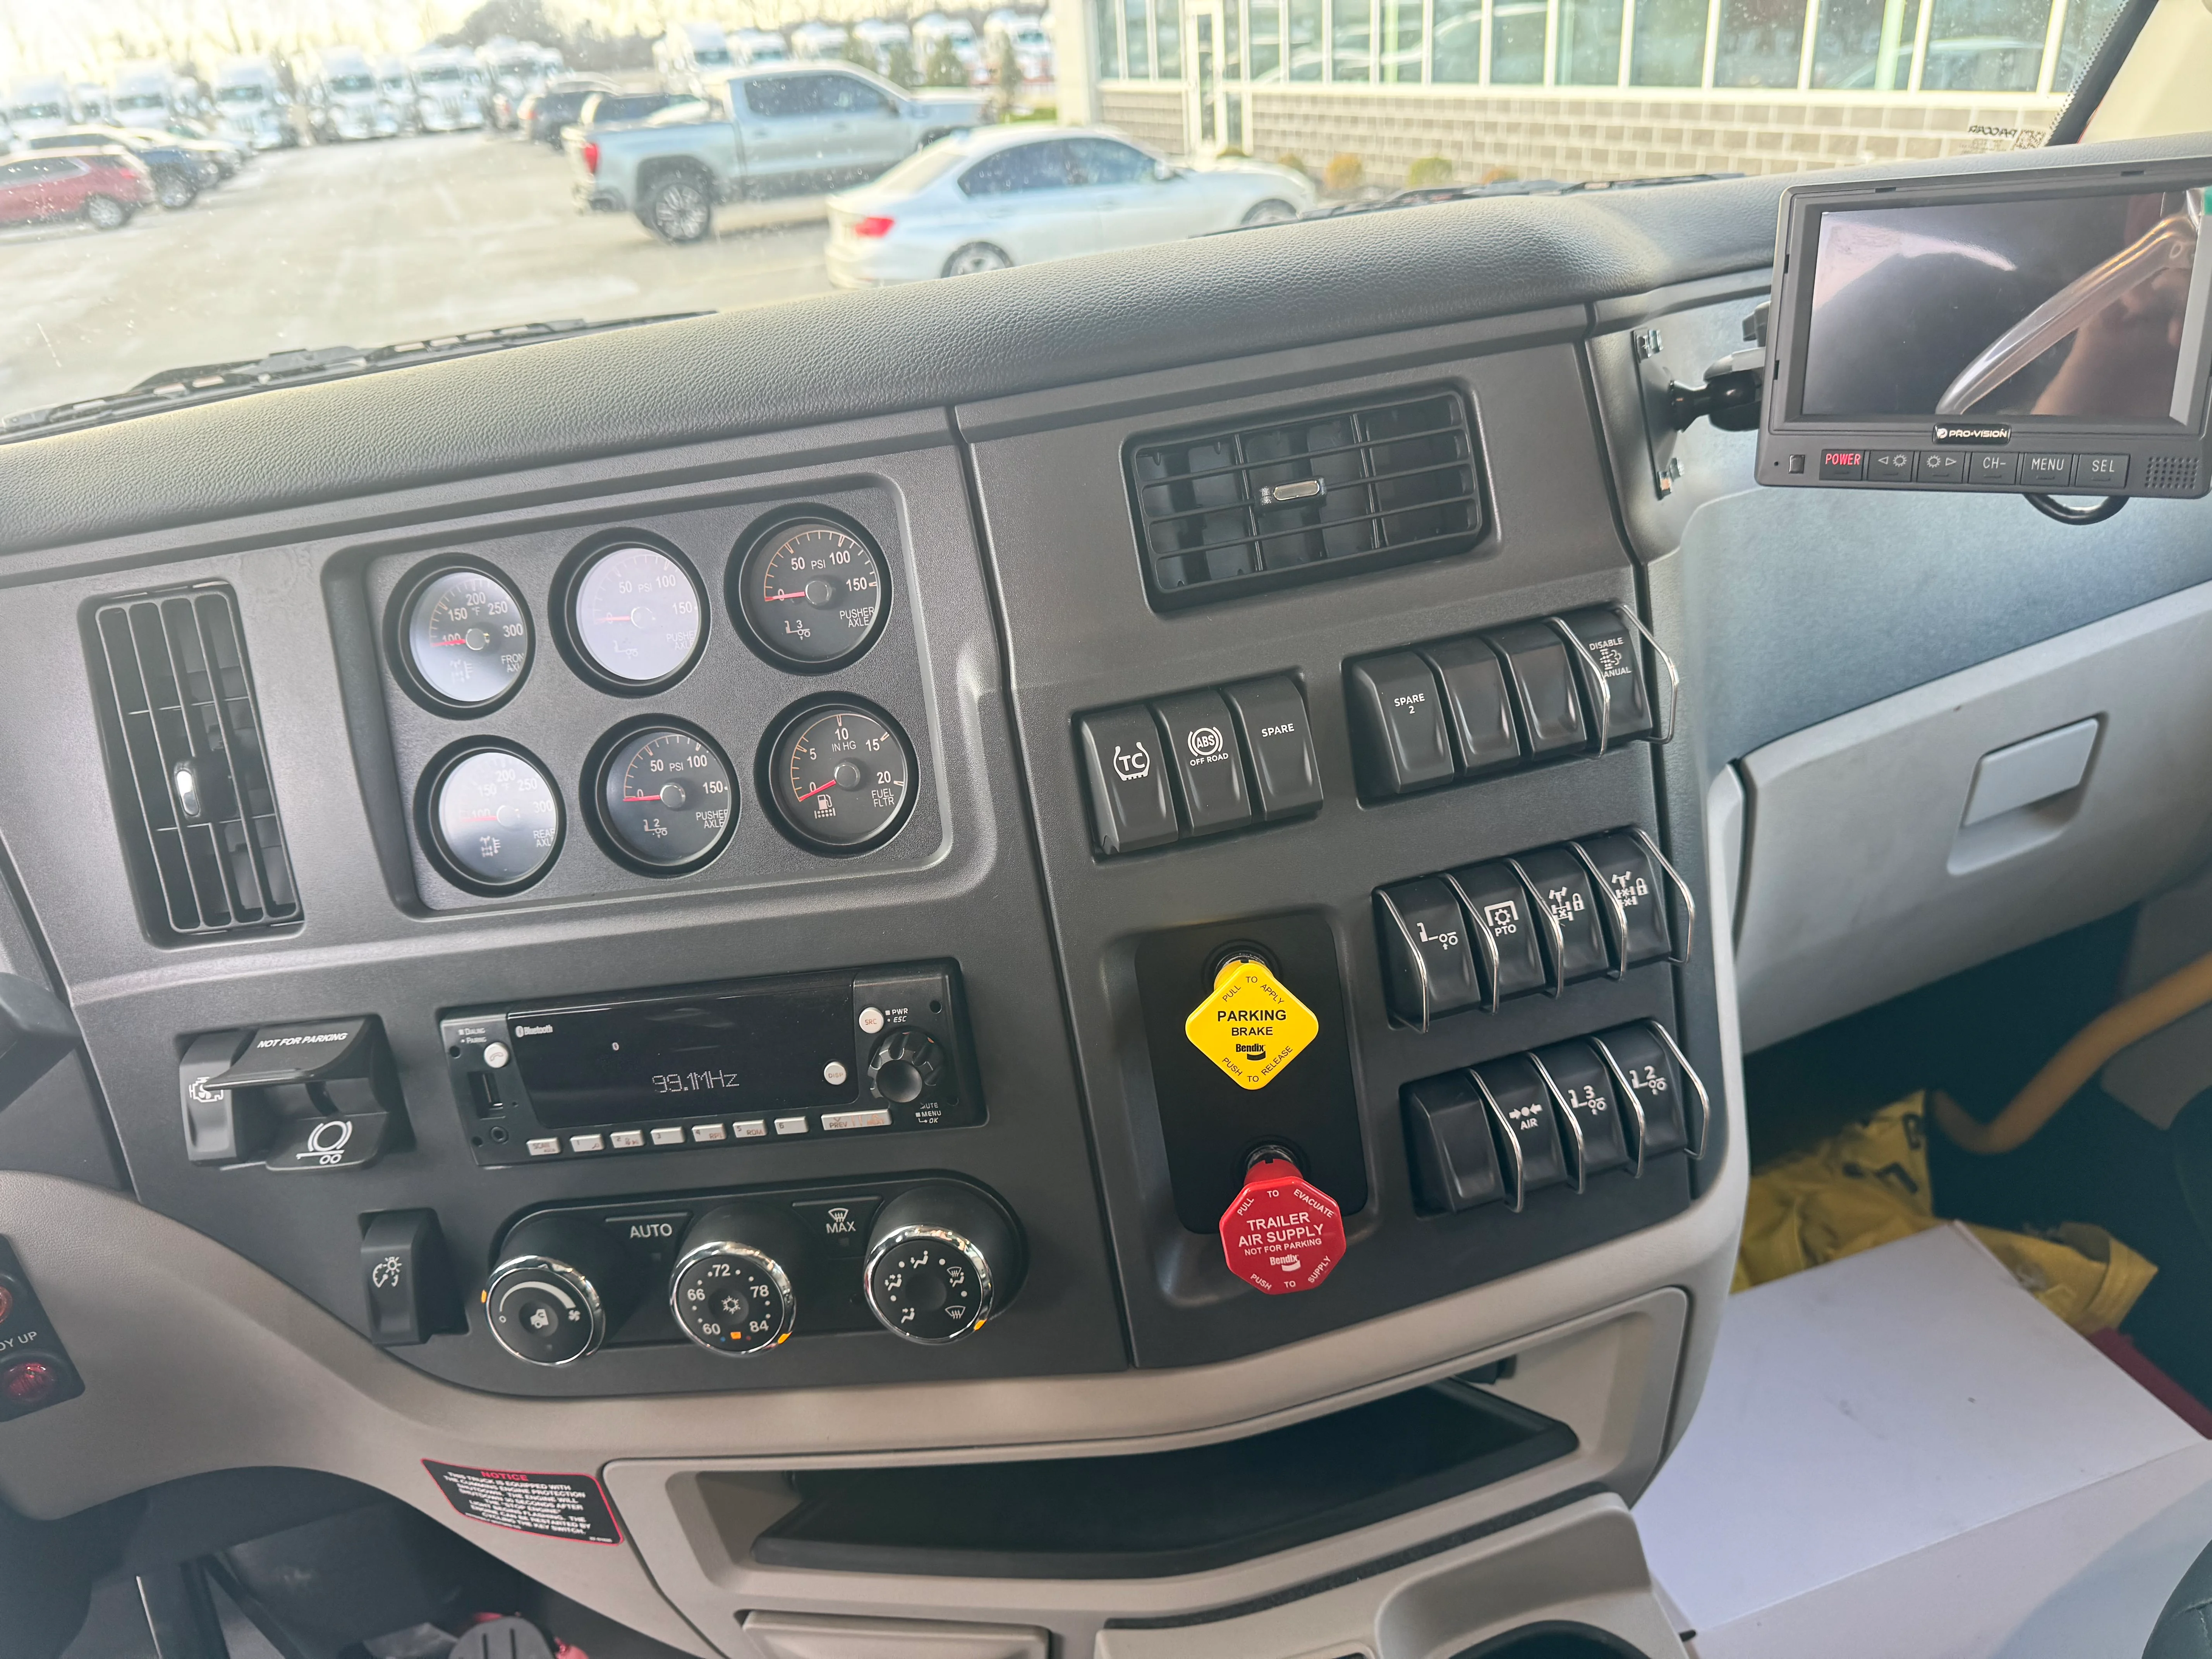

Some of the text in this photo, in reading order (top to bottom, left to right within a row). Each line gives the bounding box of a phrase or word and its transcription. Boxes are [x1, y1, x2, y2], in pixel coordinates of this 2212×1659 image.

[1825, 453, 1861, 466] POWER
[1982, 457, 2006, 469] CH-
[2031, 458, 2064, 471] MENU
[2092, 459, 2115, 473] SEL
[791, 557, 805, 570] 50
[829, 550, 850, 565] 100
[811, 559, 826, 570] PSI
[619, 580, 632, 593] 50
[656, 574, 676, 588] 100
[846, 577, 867, 591] 150
[638, 583, 652, 593] PSI
[466, 592, 486, 606] 200
[448, 607, 467, 621] 150
[488, 601, 508, 615] 250
[672, 601, 692, 615] 150
[840, 606, 875, 620] PUSHER
[848, 617, 869, 628] AXLE
[502, 623, 523, 637] 300
[1589, 637, 1625, 651] DISABLE
[501, 653, 524, 665] FRON
[1603, 666, 1632, 678] ANUAL
[1394, 693, 1425, 707] SPARE
[1409, 705, 1415, 714] 2
[835, 728, 849, 740] 10
[1261, 723, 1295, 737] SPARE
[831, 741, 856, 752] IN HG
[865, 738, 880, 751] 15
[1197, 735, 1215, 749] ABS
[810, 748, 817, 760] 5
[1190, 752, 1229, 766] OFF ROAD
[651, 759, 663, 772] 50
[669, 762, 684, 771] PSI
[687, 755, 707, 768] 100
[1118, 752, 1146, 771] TC
[495, 768, 515, 782] 200
[877, 771, 891, 784] 20
[517, 778, 538, 791] 250
[703, 781, 723, 794] 150
[871, 788, 894, 799] FUEL
[533, 800, 553, 813] 300
[874, 797, 895, 807] FLTR
[704, 819, 724, 829] AXLE
[1494, 923, 1516, 937] PTO
[1222, 985, 1241, 1002] PULL
[1260, 984, 1285, 1004] APPLY
[1218, 1009, 1286, 1022] PARKING
[524, 1024, 553, 1035] Bluetooth
[1231, 1027, 1273, 1036] BRAKE
[257, 1032, 348, 1048] NOT FOR PARKING
[1236, 1043, 1264, 1052] Bendix
[1222, 1057, 1243, 1076] PUSH
[1261, 1046, 1293, 1076] RELEASE
[1644, 1065, 1656, 1079] 2
[652, 1070, 740, 1093] 99.1MHz
[1584, 1085, 1595, 1099] 3
[1520, 1117, 1538, 1130] AIR
[1237, 1188, 1334, 1218] PULL TO EVACUATE
[826, 1220, 856, 1234] MAX
[1247, 1211, 1310, 1231] TRAILER
[630, 1223, 672, 1239] AUTO
[1238, 1223, 1323, 1247] AIR SUPPLY
[1244, 1238, 1322, 1256] NOT FOR PARKING
[1269, 1254, 1299, 1266] Bendix
[712, 1264, 731, 1277] 72
[1250, 1255, 1331, 1291] PUSH TO SUPPLY
[687, 1288, 705, 1301] 66
[750, 1285, 769, 1298] 78
[703, 1323, 721, 1335] 60
[749, 1320, 769, 1332] 84
[18, 1331, 37, 1343] UP
[481, 1471, 529, 1482] NOTICE
